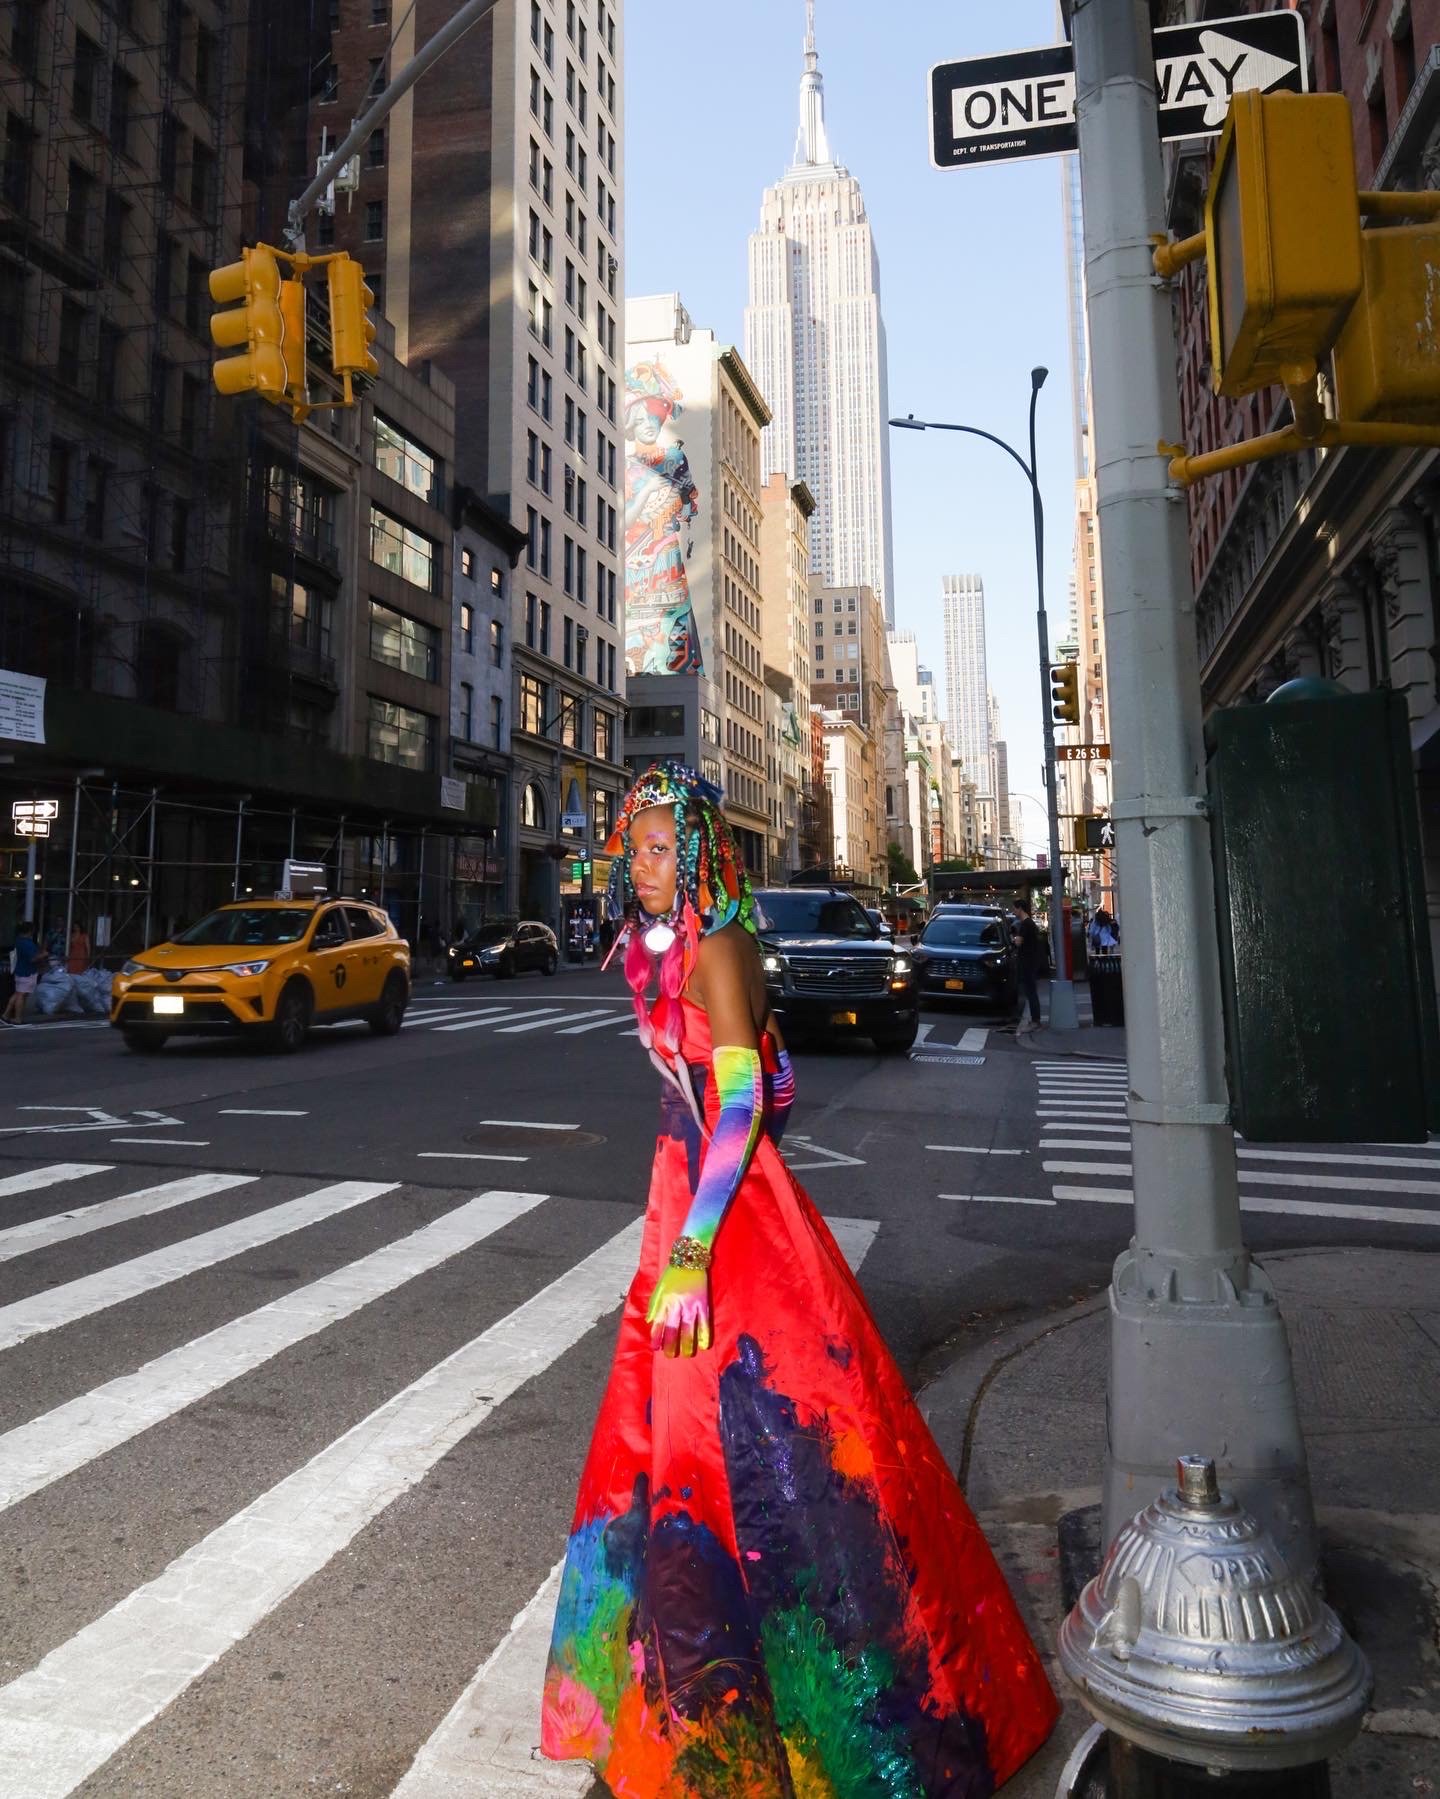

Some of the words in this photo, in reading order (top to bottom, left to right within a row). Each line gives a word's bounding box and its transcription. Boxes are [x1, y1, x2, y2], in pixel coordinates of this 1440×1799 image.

[964, 79, 1067, 130] ONE
[979, 140, 1027, 152] TRANSPORTATION
[1067, 749, 1072, 760] E
[1075, 748, 1087, 760] 26
[1090, 747, 1100, 759] St
